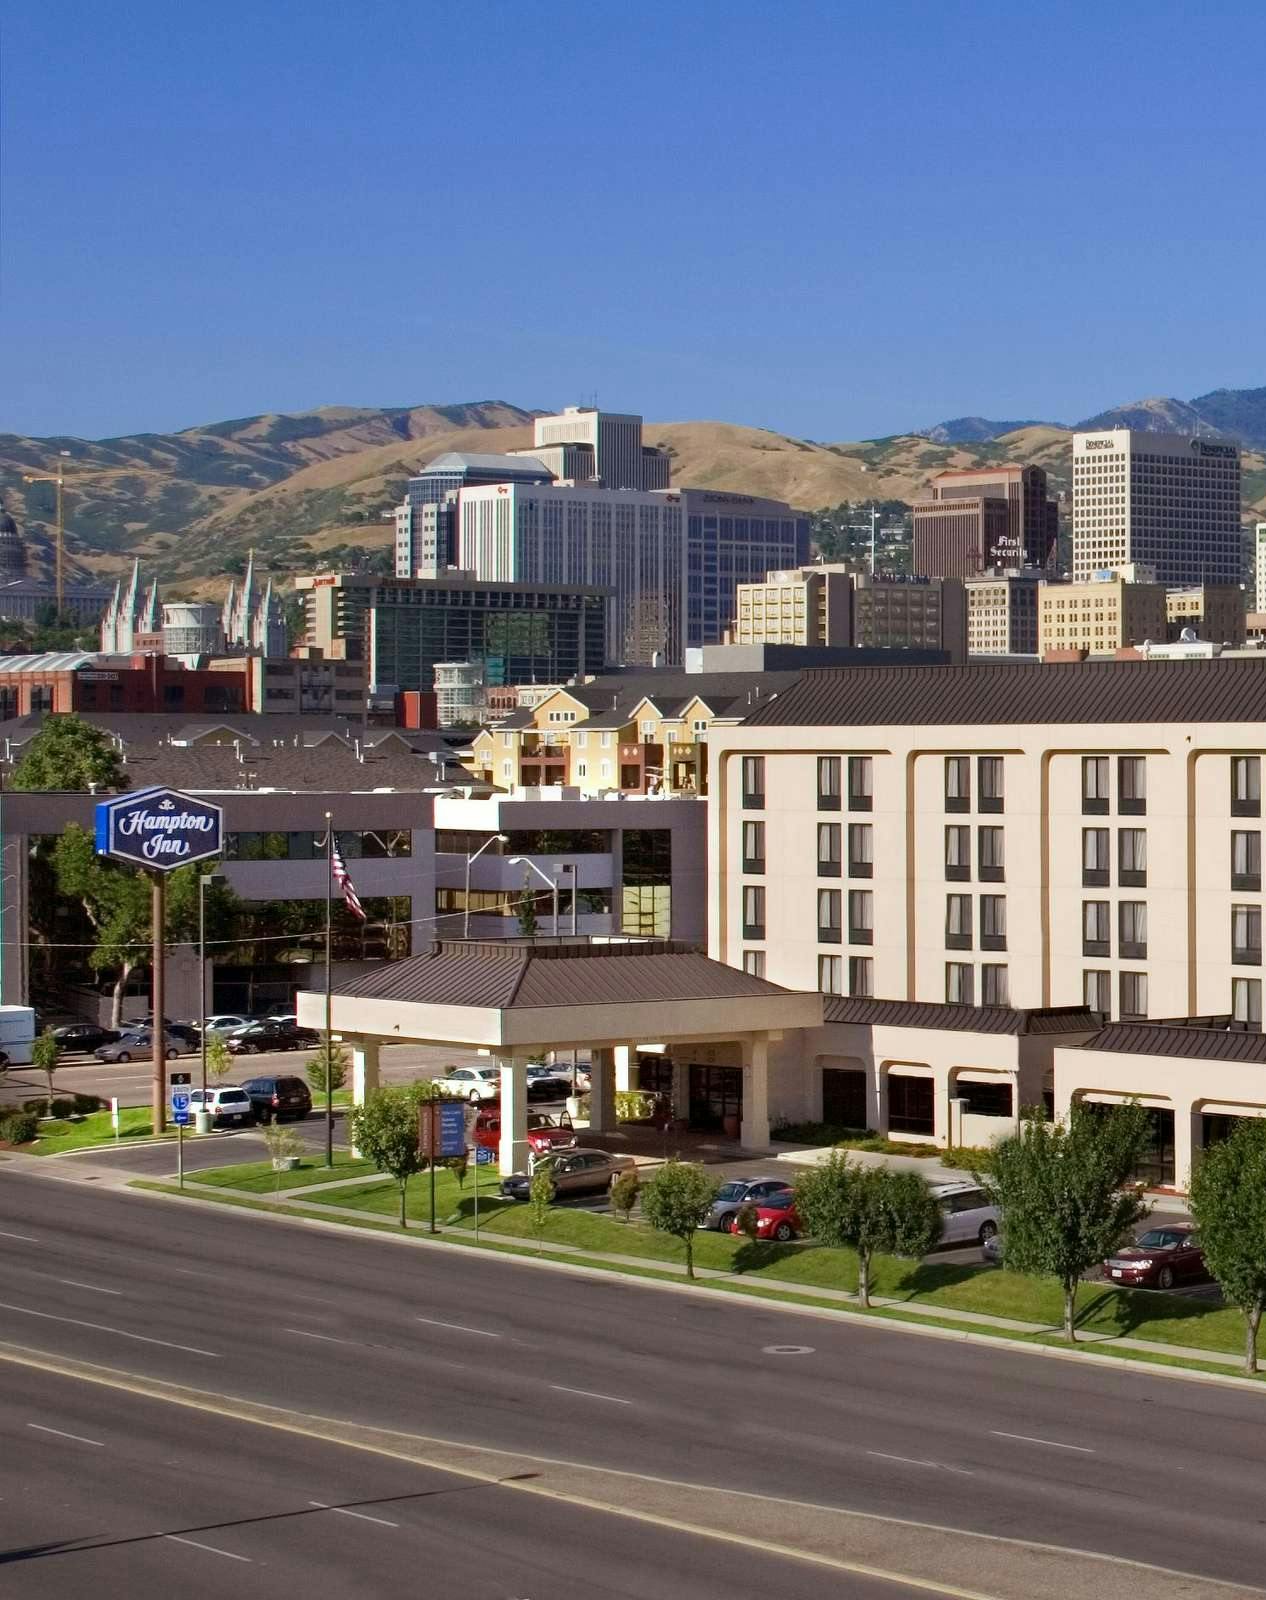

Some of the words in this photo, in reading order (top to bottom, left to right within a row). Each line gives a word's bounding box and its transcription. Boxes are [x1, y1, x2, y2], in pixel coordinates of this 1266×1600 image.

[998, 536, 1020, 546] First
[990, 546, 1028, 559] Security
[119, 810, 214, 836] Hampton
[142, 834, 189, 859] Inn
[176, 1097, 188, 1107] 15
